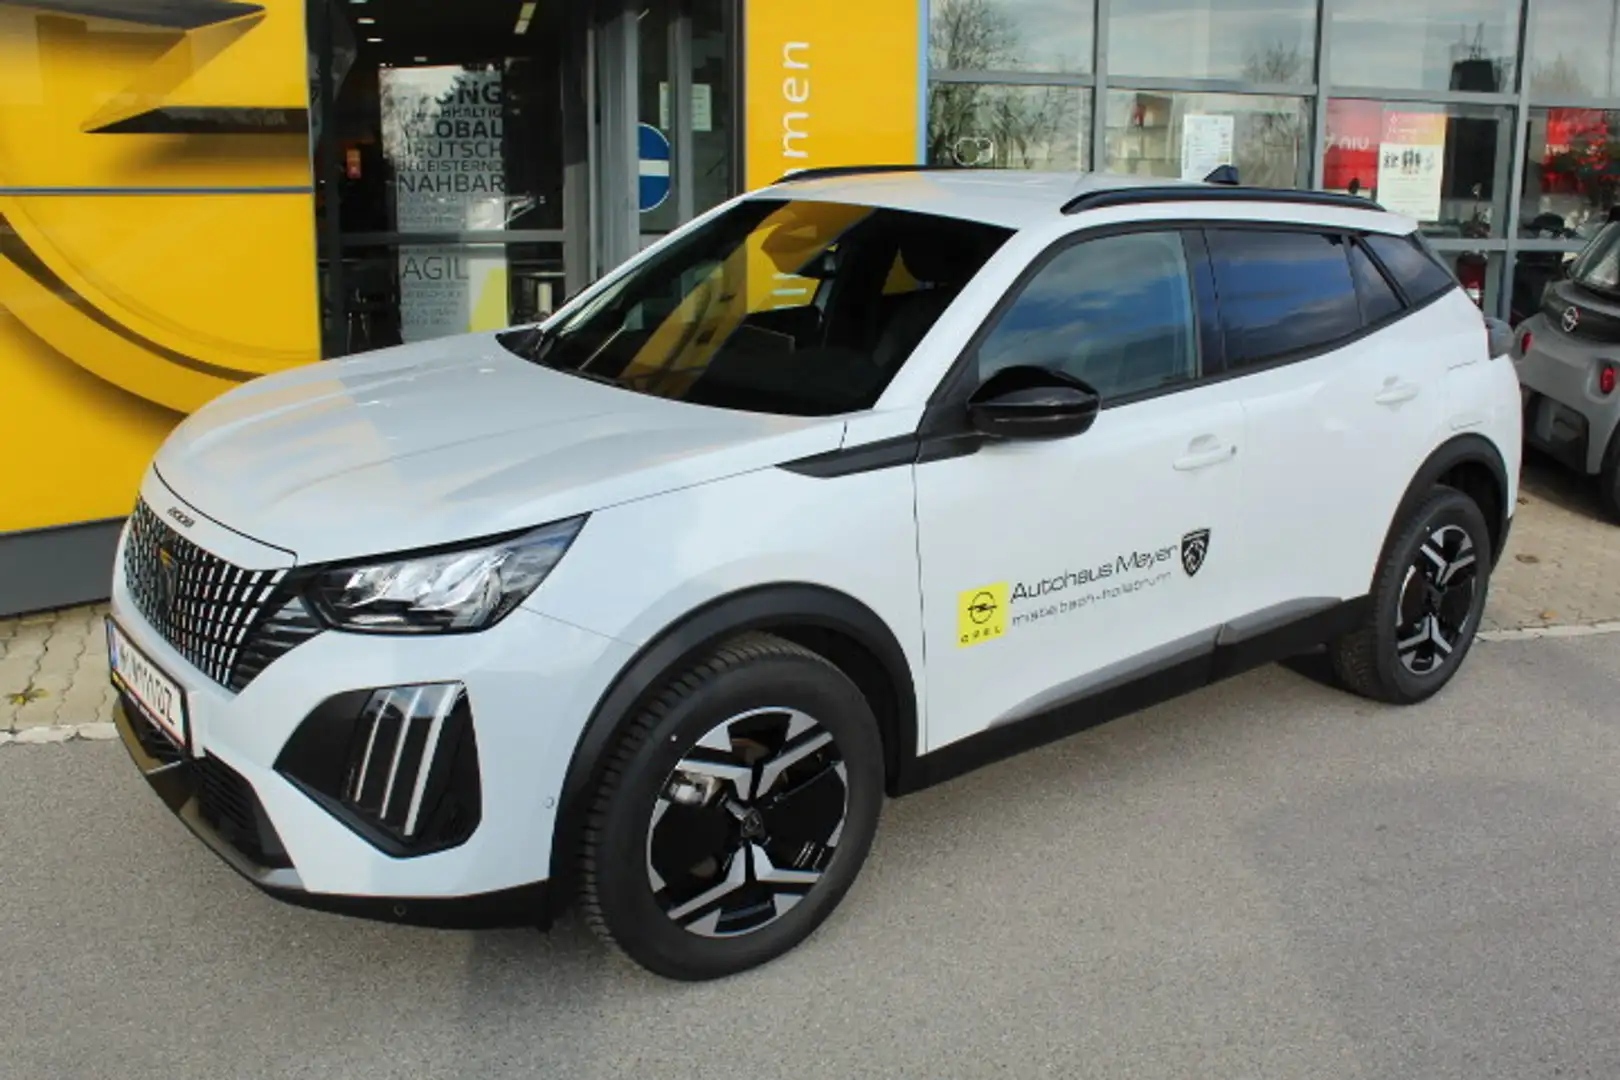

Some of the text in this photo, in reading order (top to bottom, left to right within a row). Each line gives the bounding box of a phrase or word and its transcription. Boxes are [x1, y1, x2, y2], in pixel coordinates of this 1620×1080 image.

[782, 41, 810, 177] men
[398, 173, 506, 193] NAHBAR
[402, 256, 470, 281] AGIL
[1009, 563, 1113, 602] Autohaus
